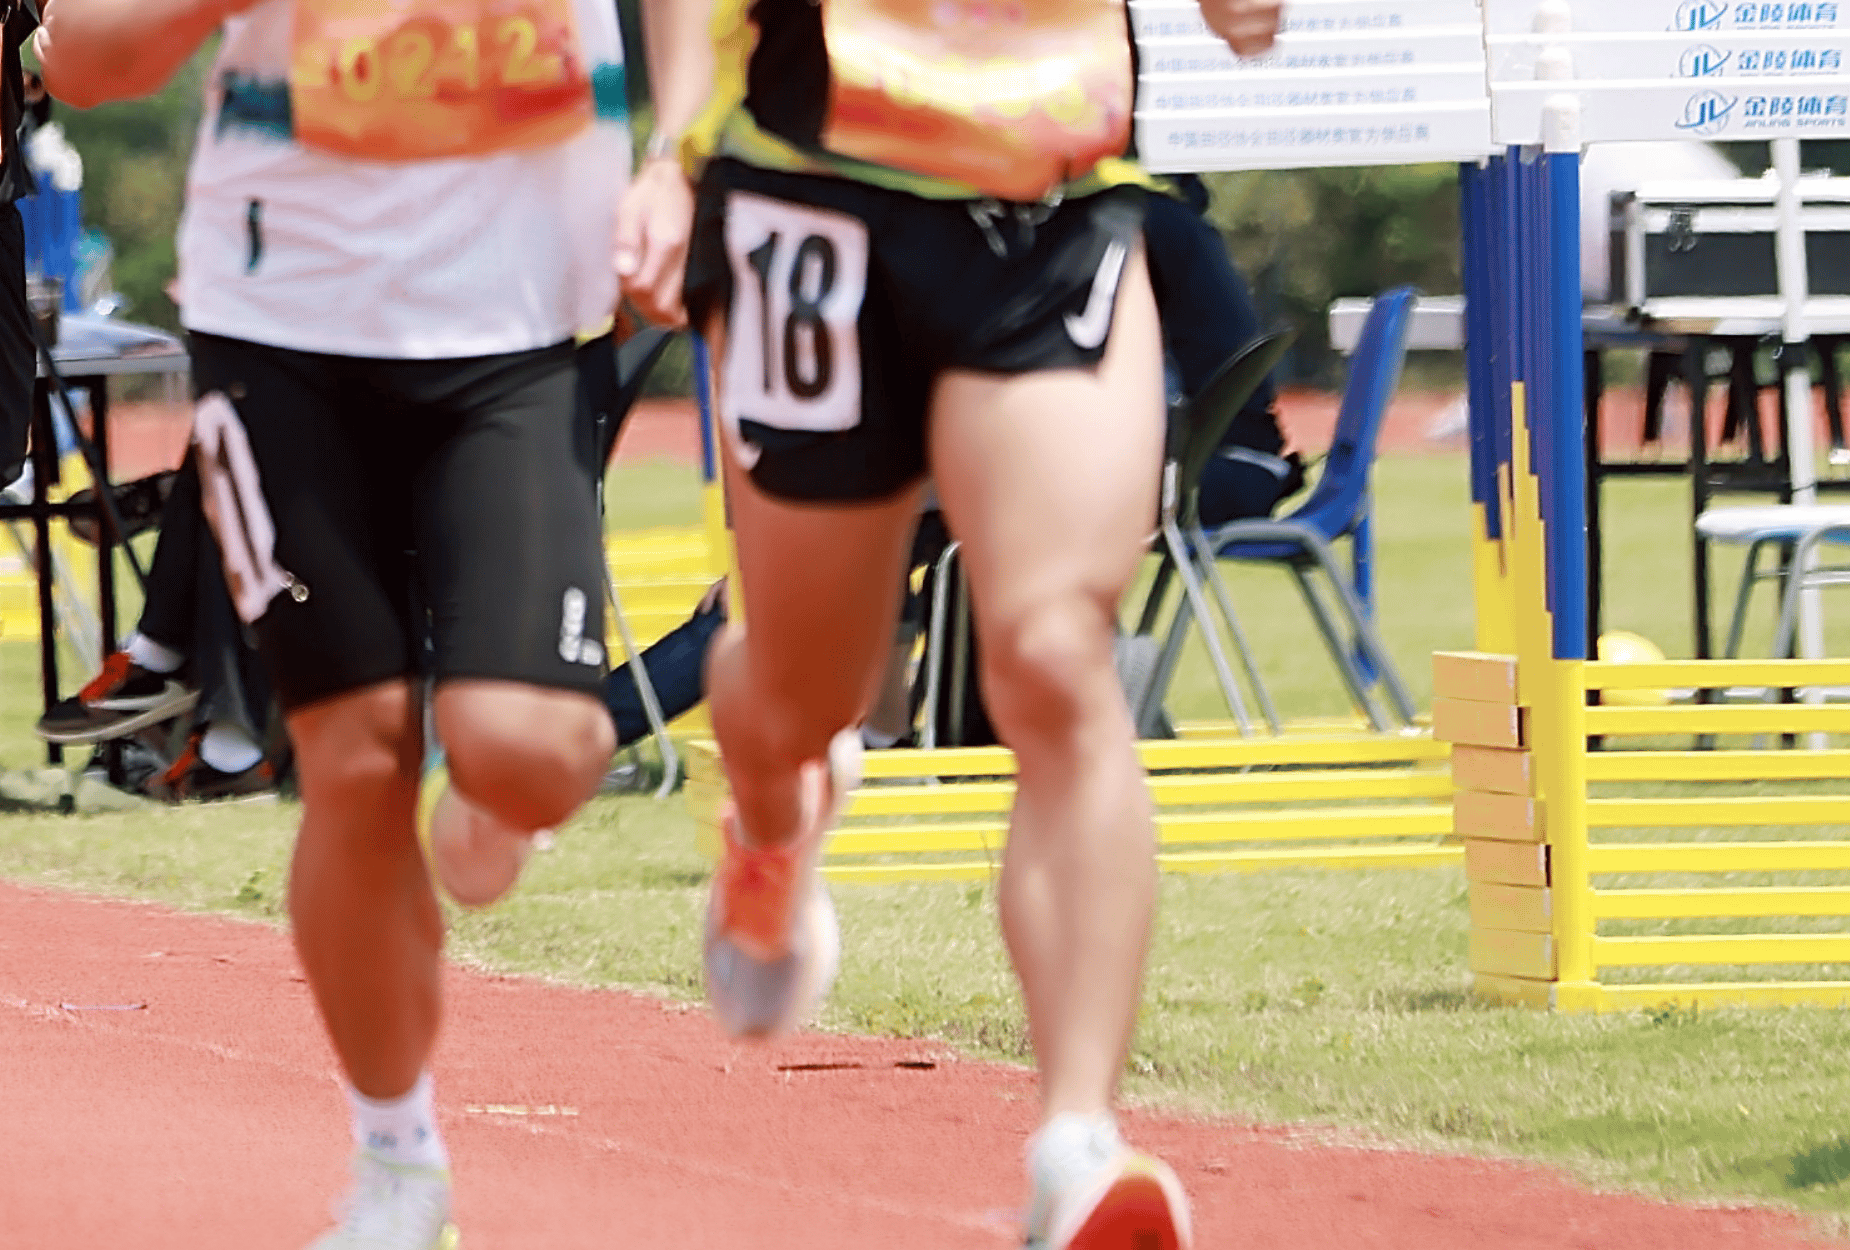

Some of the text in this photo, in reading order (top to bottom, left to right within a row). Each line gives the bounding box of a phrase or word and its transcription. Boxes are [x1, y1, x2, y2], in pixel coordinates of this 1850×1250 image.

[1735, 2, 1838, 24] 金陵体育
[1738, 49, 1841, 70] 金陵体育
[1744, 95, 1847, 116] 金陵体育
[1797, 118, 1846, 127] SPORTS
[746, 231, 838, 401] 18
